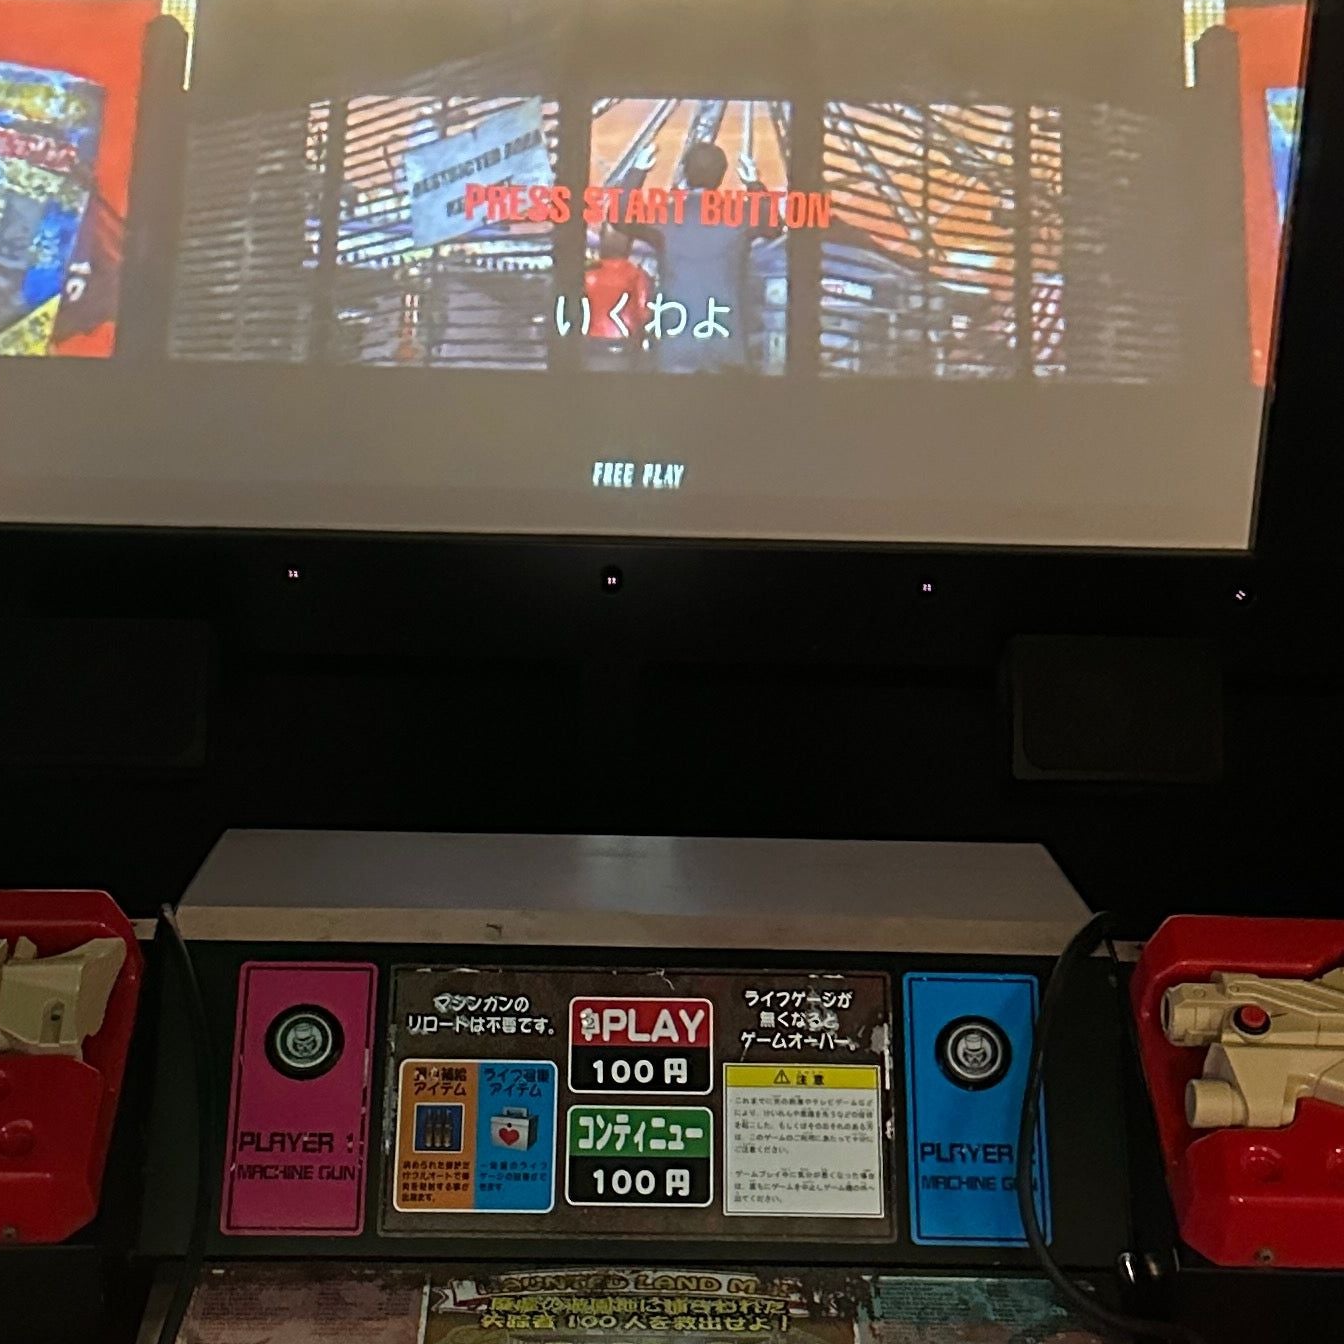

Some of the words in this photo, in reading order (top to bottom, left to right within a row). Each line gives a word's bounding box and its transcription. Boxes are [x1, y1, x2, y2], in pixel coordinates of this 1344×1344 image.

[464, 182, 571, 224] PRESS
[581, 185, 688, 225] START
[700, 188, 832, 229] BUTTON
[555, 290, 732, 340] いくわよ
[591, 462, 634, 487] FREE
[642, 463, 685, 489] PLAY
[432, 993, 530, 1014] マシンガンの
[744, 990, 854, 1009] ライフゲージが
[413, 1082, 467, 1096] アイテム
[489, 1083, 542, 1098] アイテム
[239, 1131, 334, 1154] PLAYER
[578, 1113, 703, 1153] コンティニュー
[919, 1142, 1014, 1164] PLAYER
[237, 1164, 314, 1180] MACHINE
[318, 1165, 356, 1181] GUN
[921, 1175, 997, 1192] MACHINE
[634, 1275, 722, 1293] LAND
